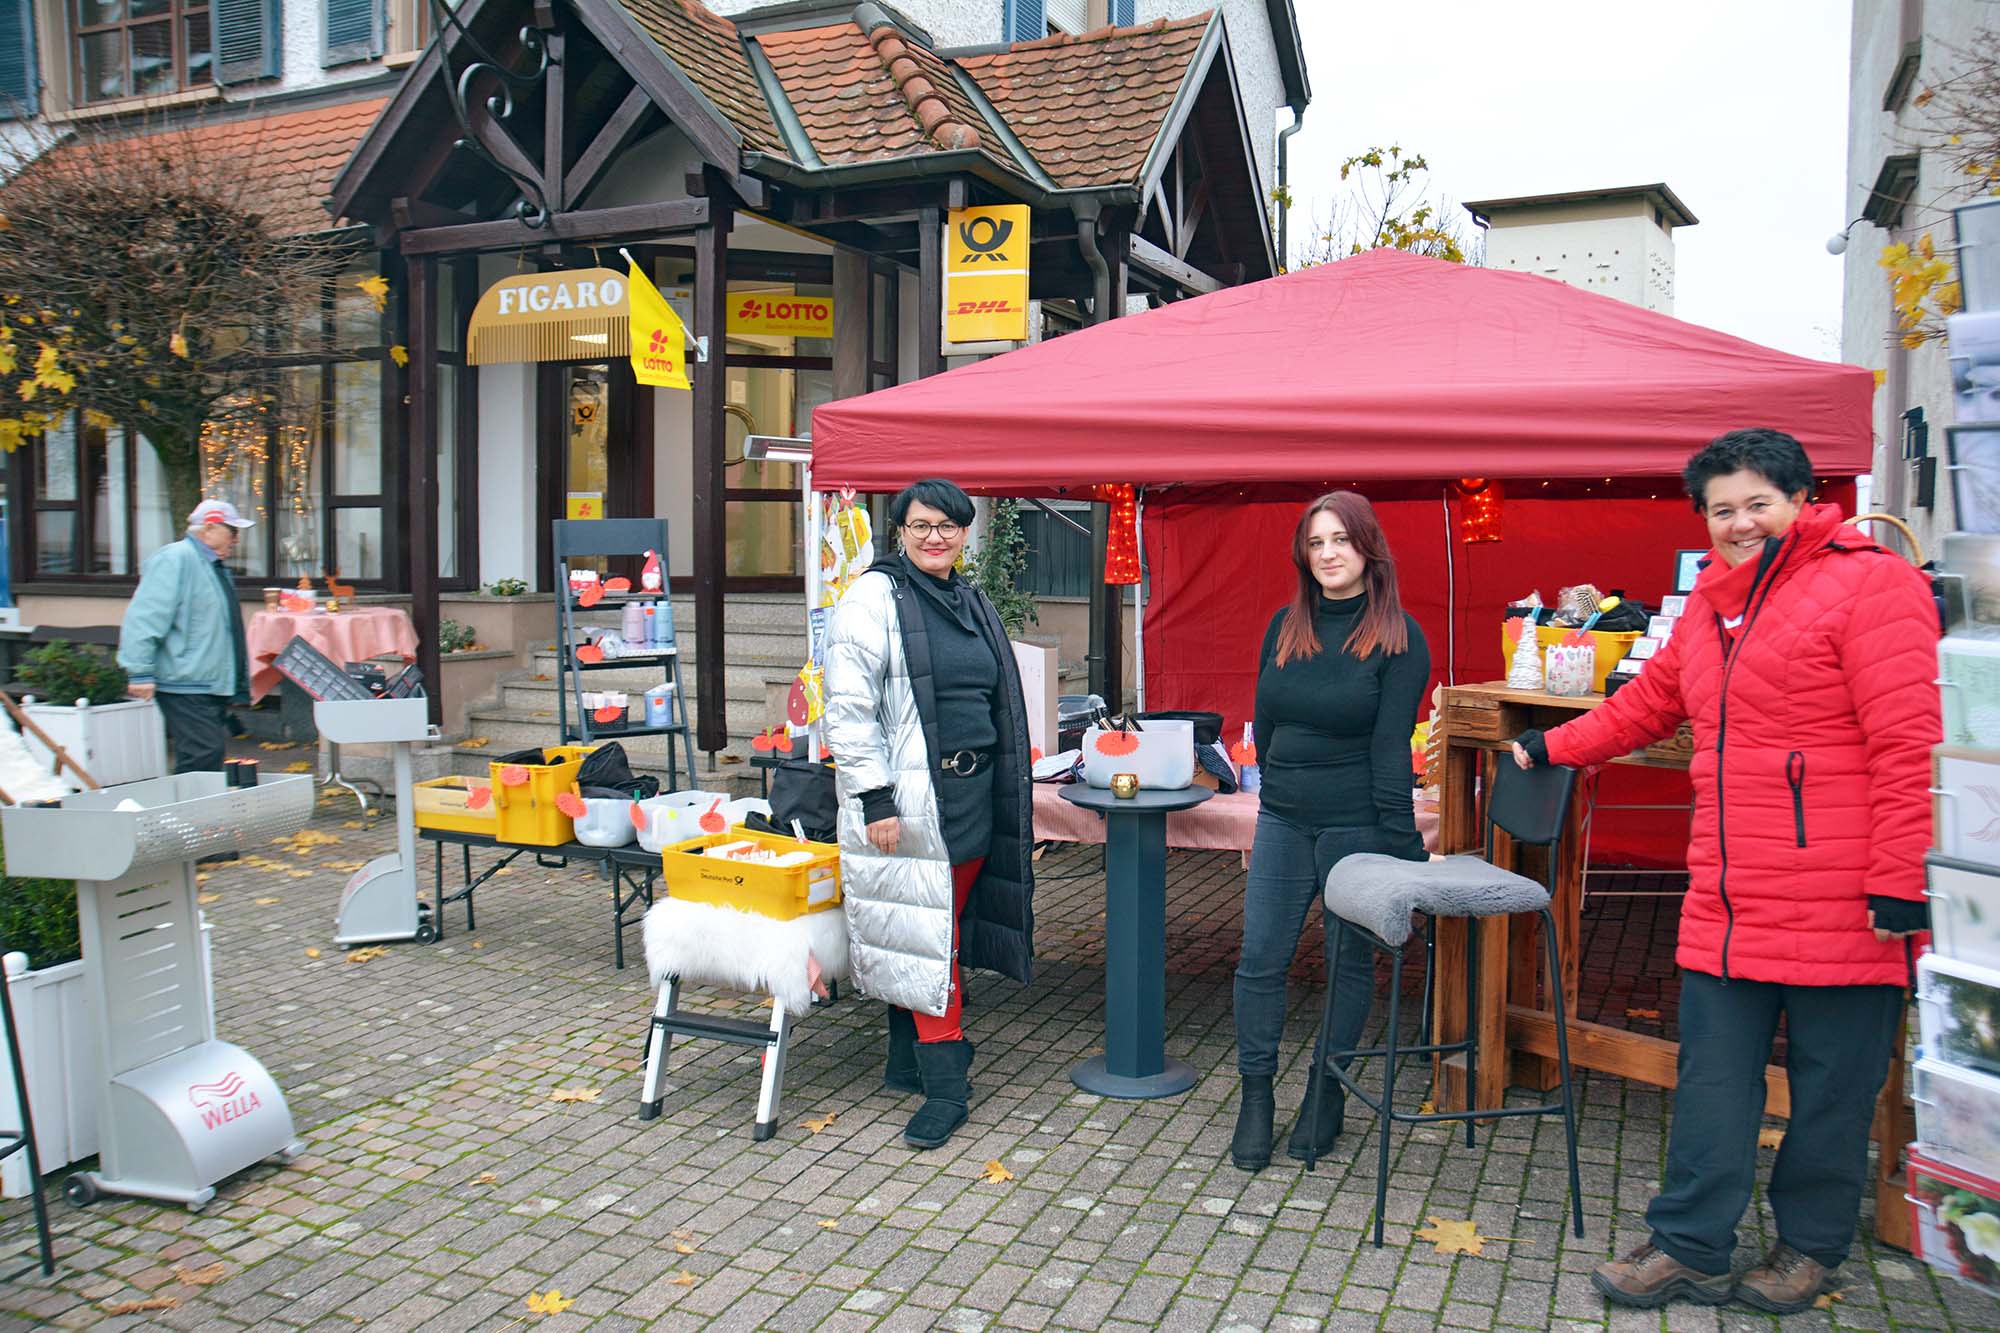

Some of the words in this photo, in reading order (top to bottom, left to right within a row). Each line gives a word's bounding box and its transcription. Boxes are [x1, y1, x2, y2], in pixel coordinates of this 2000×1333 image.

[498, 279, 623, 315] FIGARO
[766, 302, 828, 321] LOTTO
[958, 300, 1011, 315] DHL
[643, 357, 673, 373] LOTTO
[200, 1092, 262, 1130] WELLA
